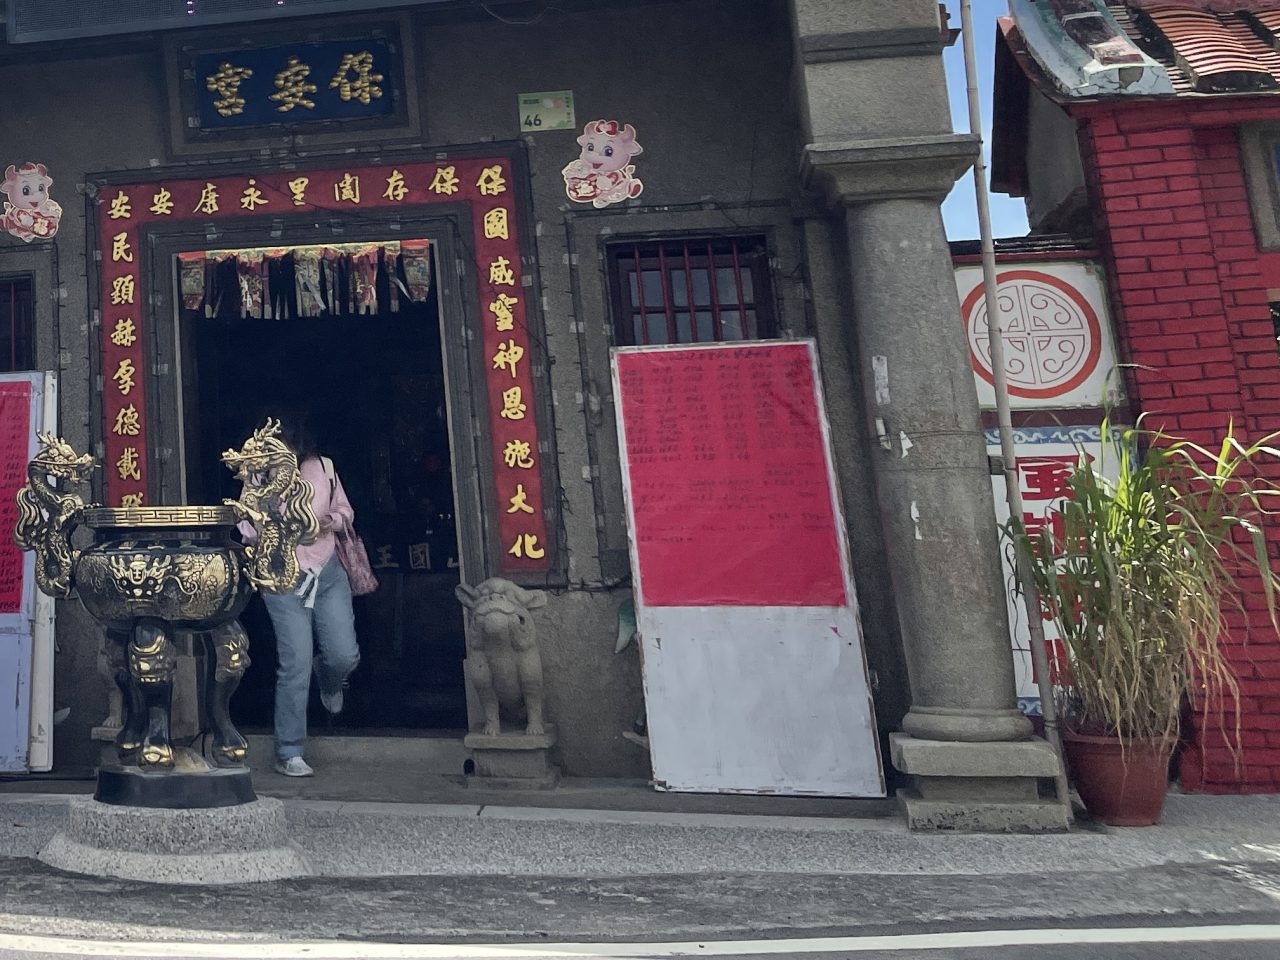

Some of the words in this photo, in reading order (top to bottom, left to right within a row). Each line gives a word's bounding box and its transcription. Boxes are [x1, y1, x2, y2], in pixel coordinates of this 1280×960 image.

[206, 50, 383, 117] 保安宮
[524, 113, 542, 127] 46
